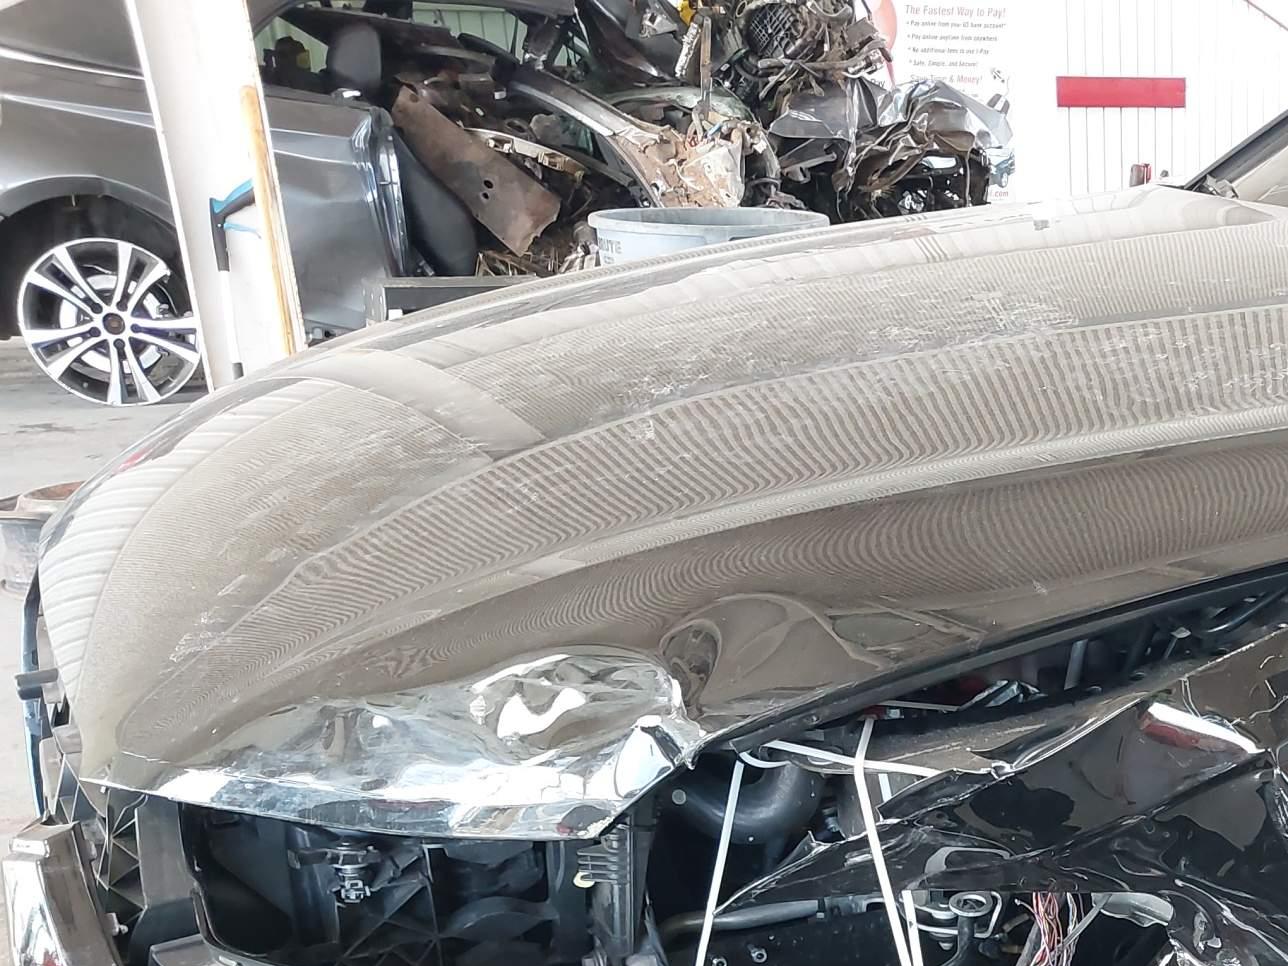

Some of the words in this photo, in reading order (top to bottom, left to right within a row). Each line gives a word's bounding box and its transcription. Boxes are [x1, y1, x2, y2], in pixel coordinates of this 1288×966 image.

[904, 5, 920, 15] The
[923, 5, 954, 16] Fastest
[956, 6, 974, 18] Way
[976, 7, 985, 16] to
[986, 7, 1006, 19] Pay!
